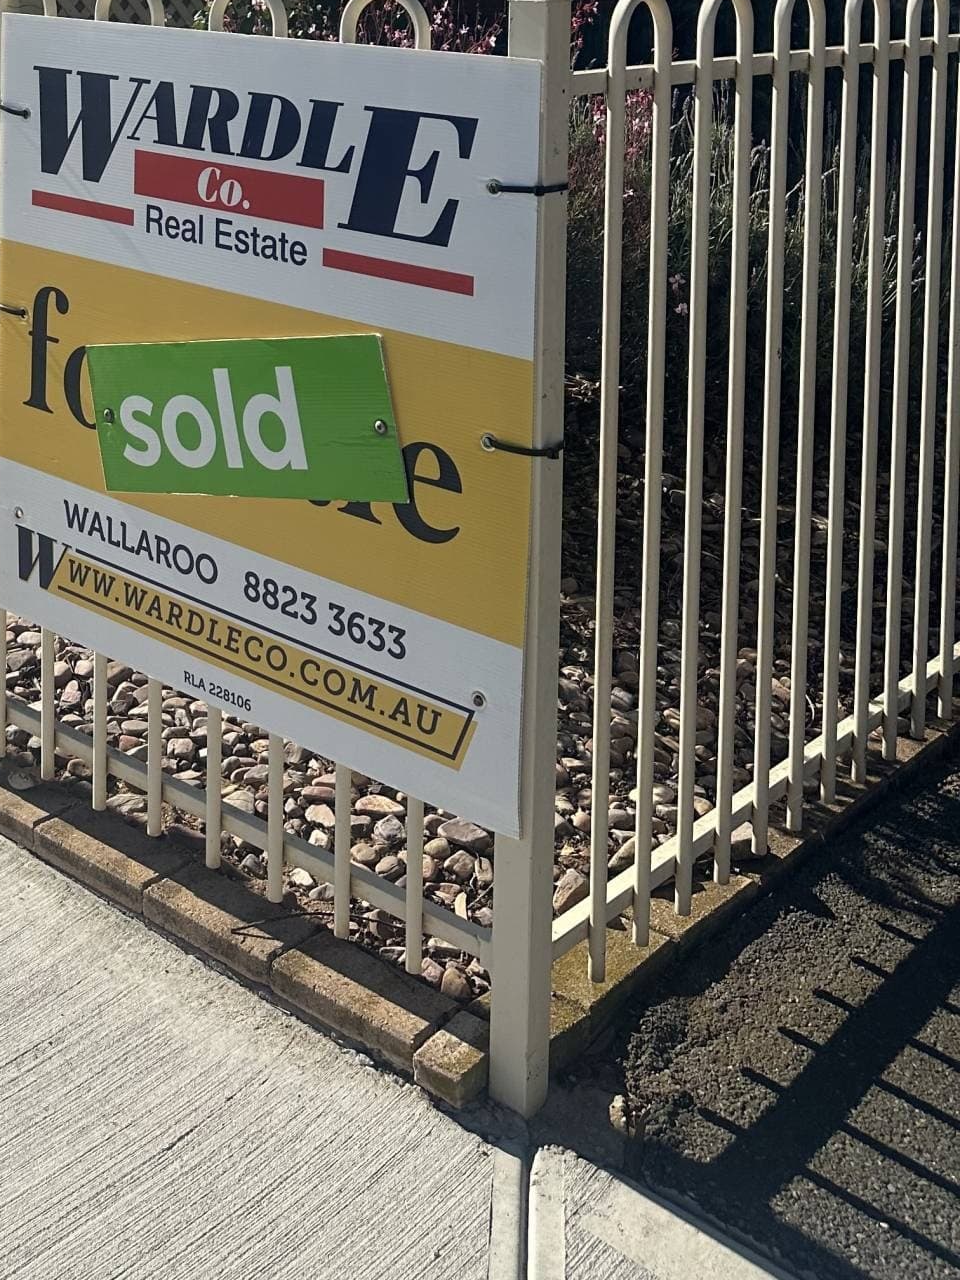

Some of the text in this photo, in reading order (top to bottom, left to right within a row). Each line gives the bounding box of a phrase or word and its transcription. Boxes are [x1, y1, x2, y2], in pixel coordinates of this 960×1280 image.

[33, 65, 479, 248] WARDLE
[197, 166, 251, 210] Co.
[145, 204, 308, 266] Real Estate
[119, 365, 309, 471] sold
[63, 499, 407, 661] WALLAROO 8823 3633
[182, 670, 252, 712] RLA 228106
